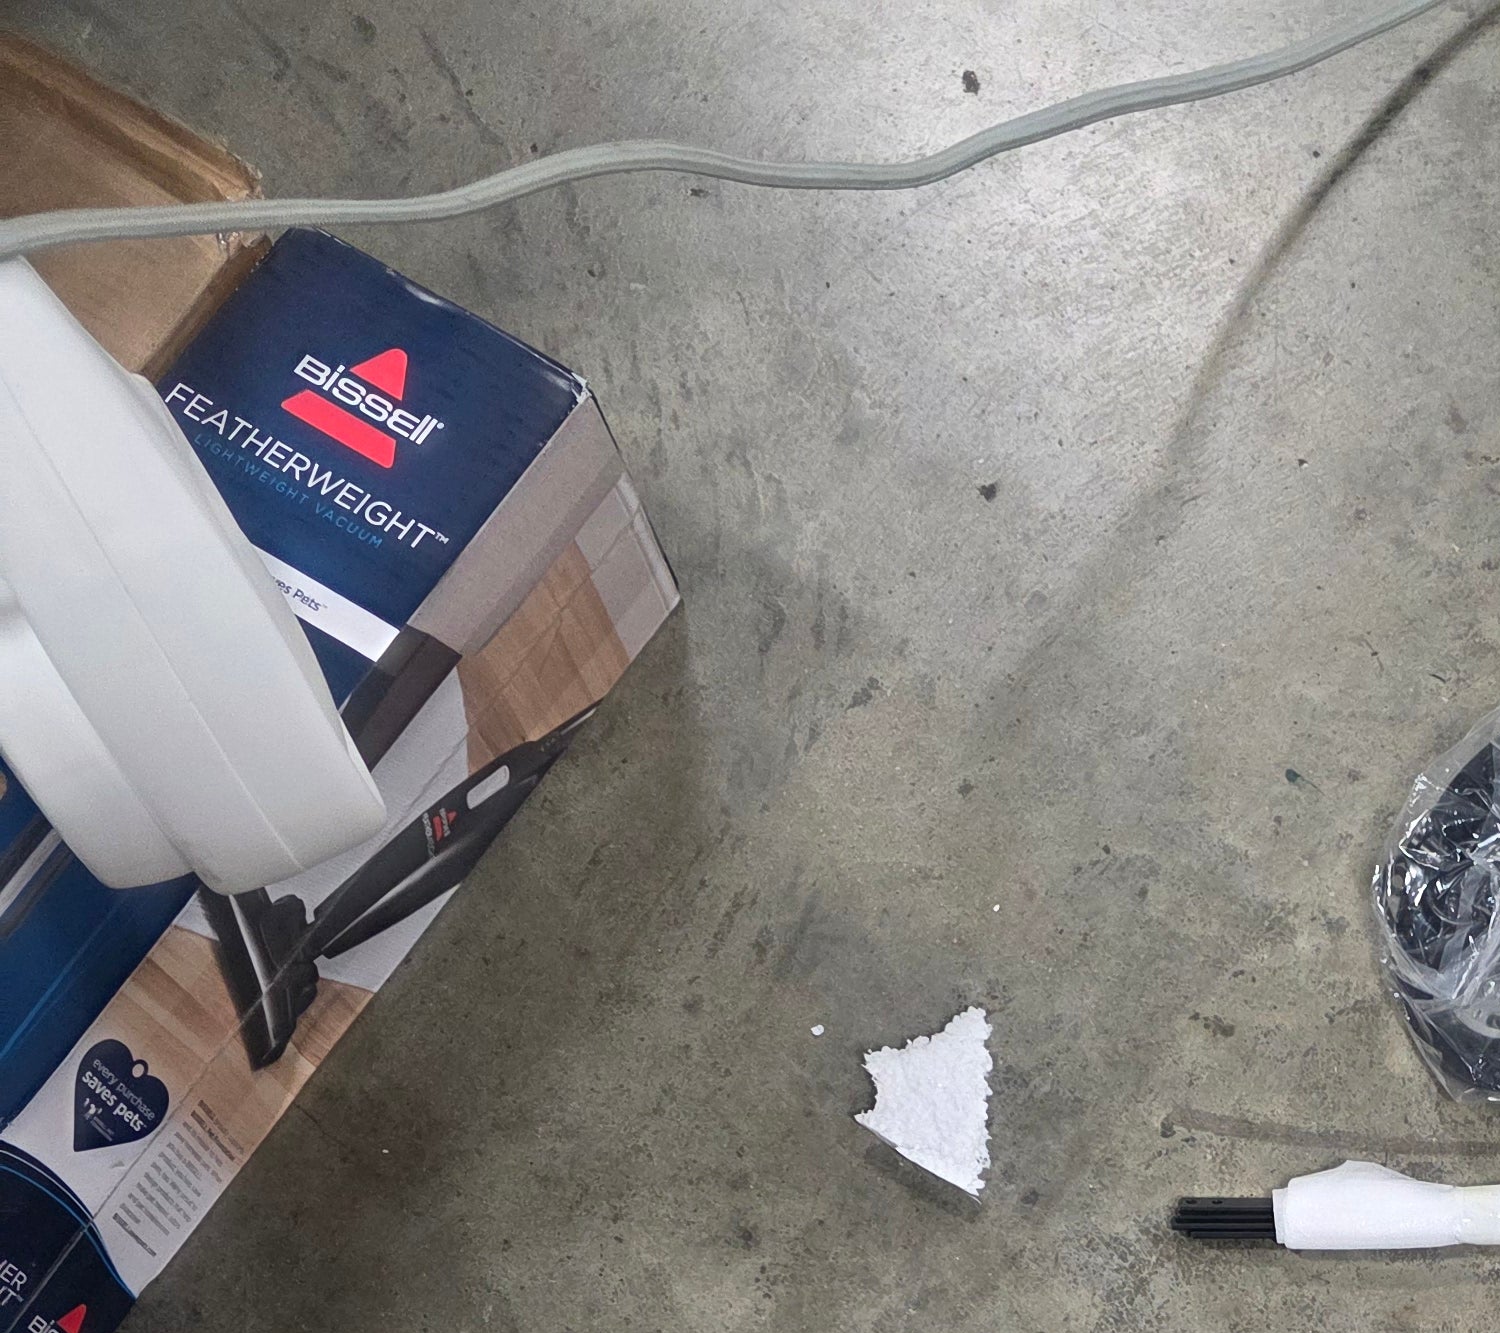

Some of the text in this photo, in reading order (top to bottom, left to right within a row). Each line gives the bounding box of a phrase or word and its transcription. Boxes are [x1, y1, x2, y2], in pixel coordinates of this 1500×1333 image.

[194, 433, 383, 549] LIGHTWEIGHT VACUUM
[82, 1071, 118, 1107] saves
[112, 1102, 145, 1132] pets
[92, 1059, 155, 1121] every purchase
